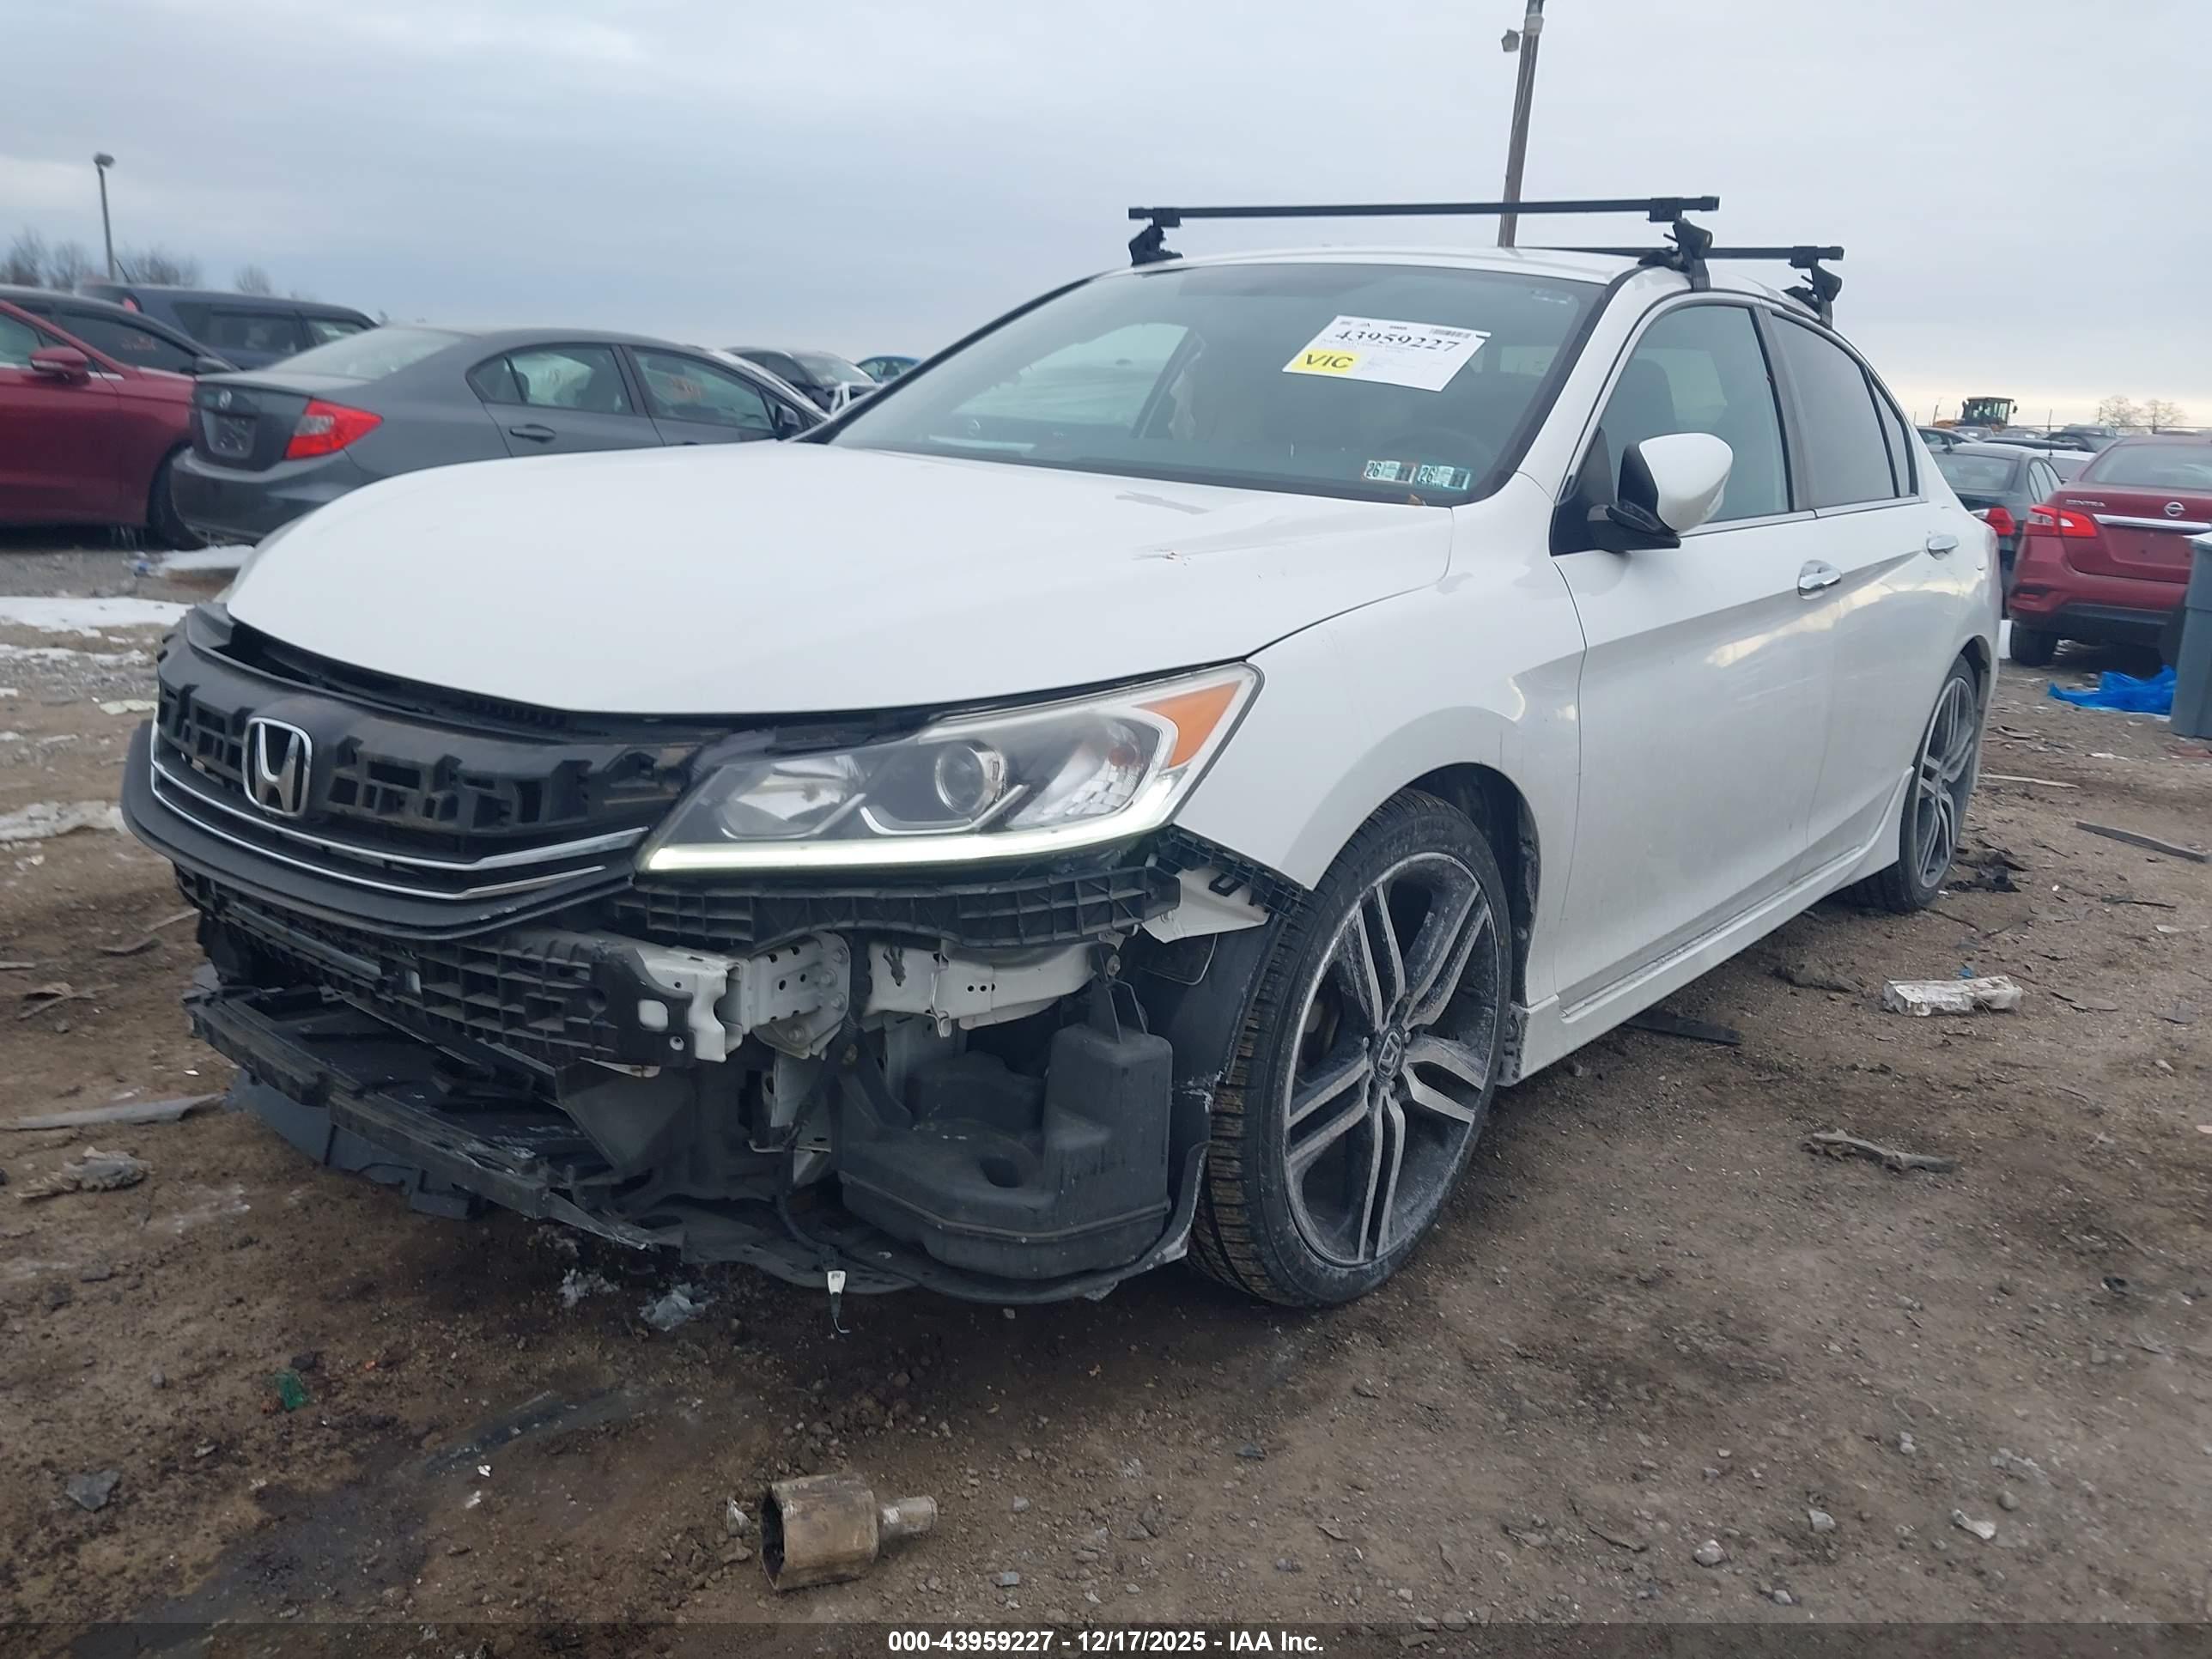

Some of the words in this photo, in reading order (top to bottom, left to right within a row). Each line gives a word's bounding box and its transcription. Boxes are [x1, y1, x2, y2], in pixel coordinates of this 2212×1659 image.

[1334, 329, 1461, 352] 43959227
[1305, 354, 1354, 369] VIC
[1366, 462, 1382, 477] 26
[1419, 466, 1437, 483] 26
